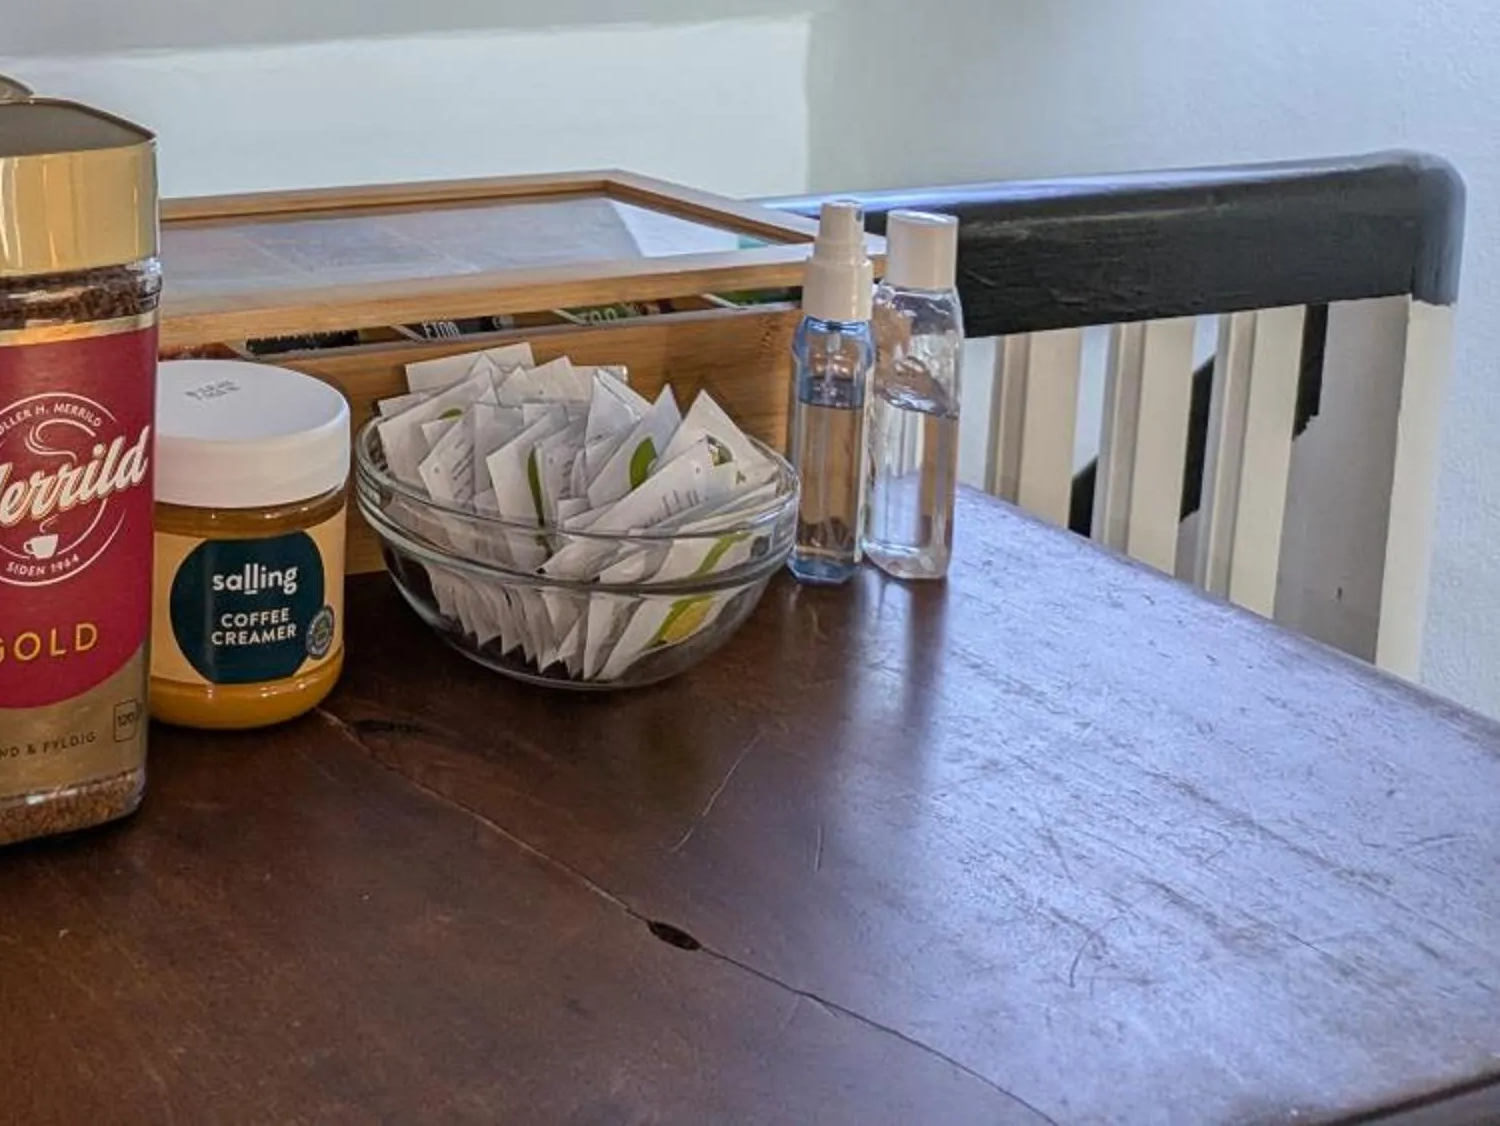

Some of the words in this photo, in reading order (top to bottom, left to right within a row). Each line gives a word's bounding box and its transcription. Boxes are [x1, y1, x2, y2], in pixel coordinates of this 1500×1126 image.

[6, 561, 46, 577] SIDEN
[212, 563, 298, 595] salling
[221, 607, 290, 628] COFFEE
[211, 623, 297, 645] CREAMER
